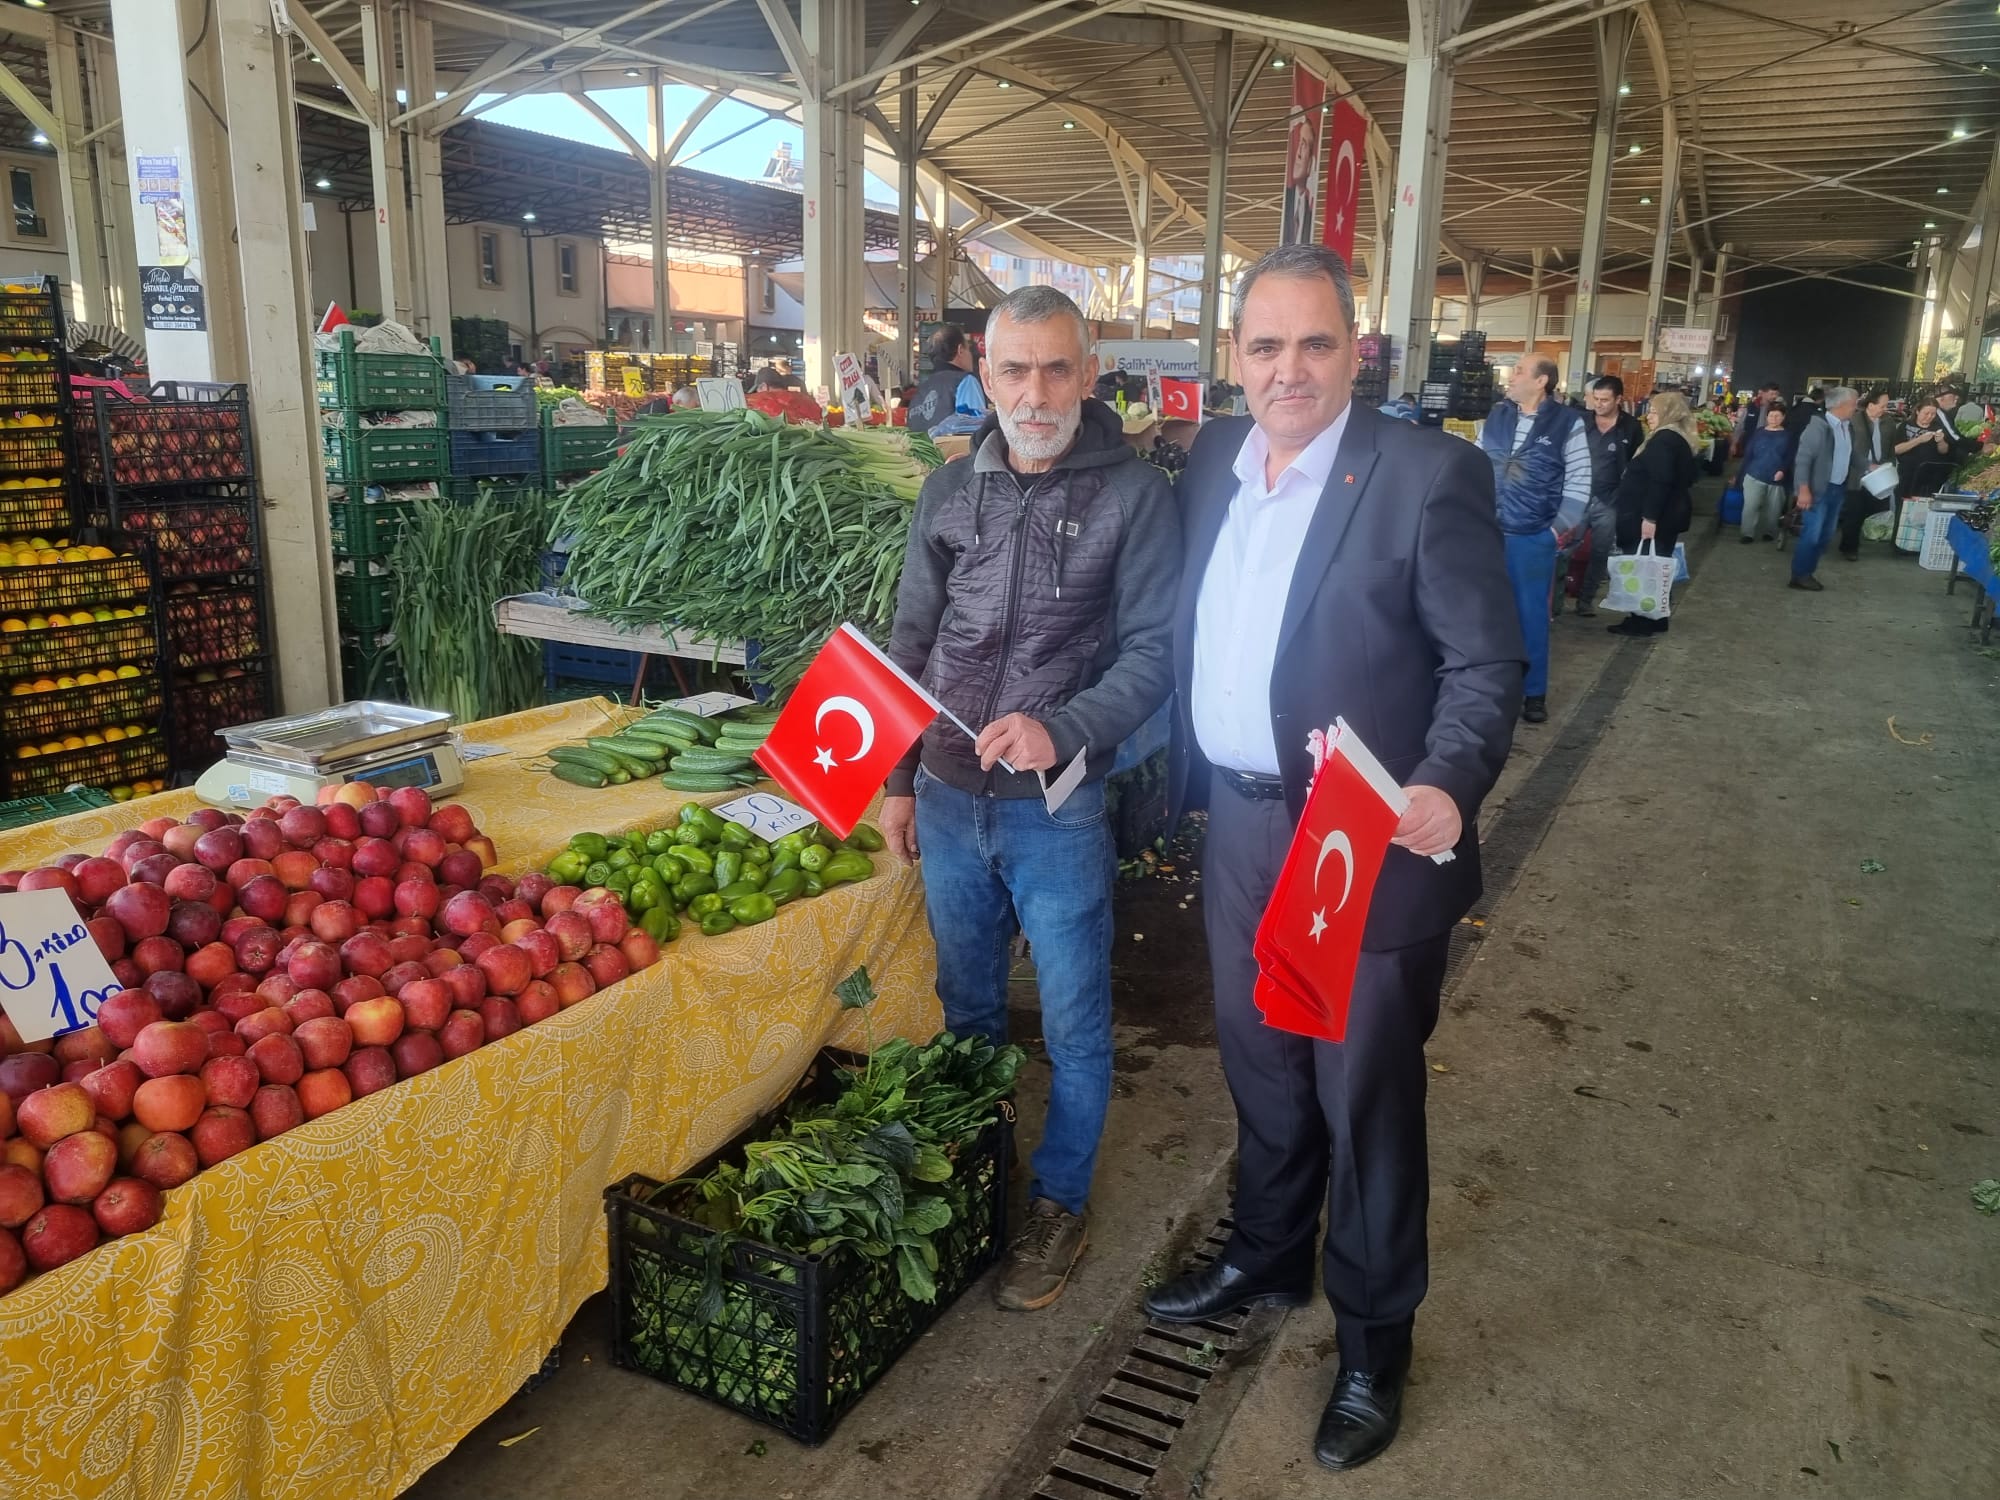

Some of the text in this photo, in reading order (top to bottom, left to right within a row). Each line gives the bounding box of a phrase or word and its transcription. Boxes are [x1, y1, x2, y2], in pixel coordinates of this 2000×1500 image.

[1402, 185, 1415, 207] 4
[379, 208, 386, 224] 2
[808, 200, 817, 219] 3
[900, 283, 905, 292] 2
[1206, 283, 1212, 293] 3
[1582, 280, 1589, 290] 4
[1155, 359, 1199, 371] Yumurt
[717, 795, 784, 828] 50
